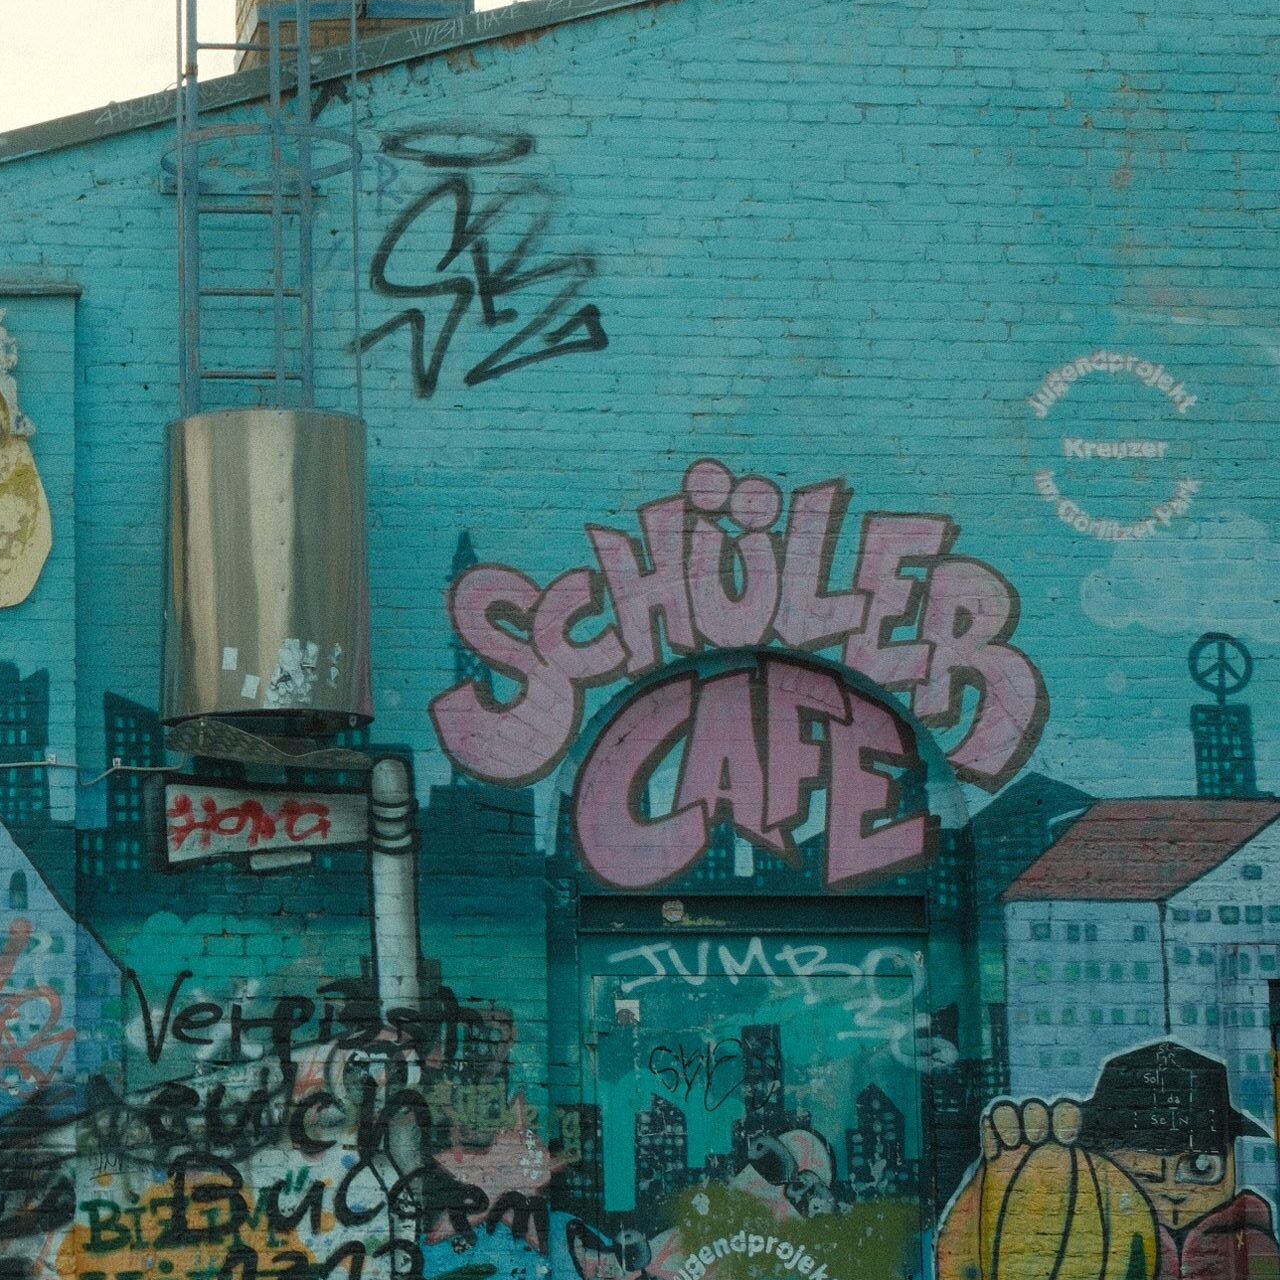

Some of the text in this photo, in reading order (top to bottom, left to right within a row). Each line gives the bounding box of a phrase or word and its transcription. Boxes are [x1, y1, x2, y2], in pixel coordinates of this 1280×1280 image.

[1061, 437, 1168, 460] Kreuzer
[428, 457, 1050, 794] SCHÜLER
[573, 652, 942, 894] CAFE
[607, 936, 927, 1007] JUMBO
